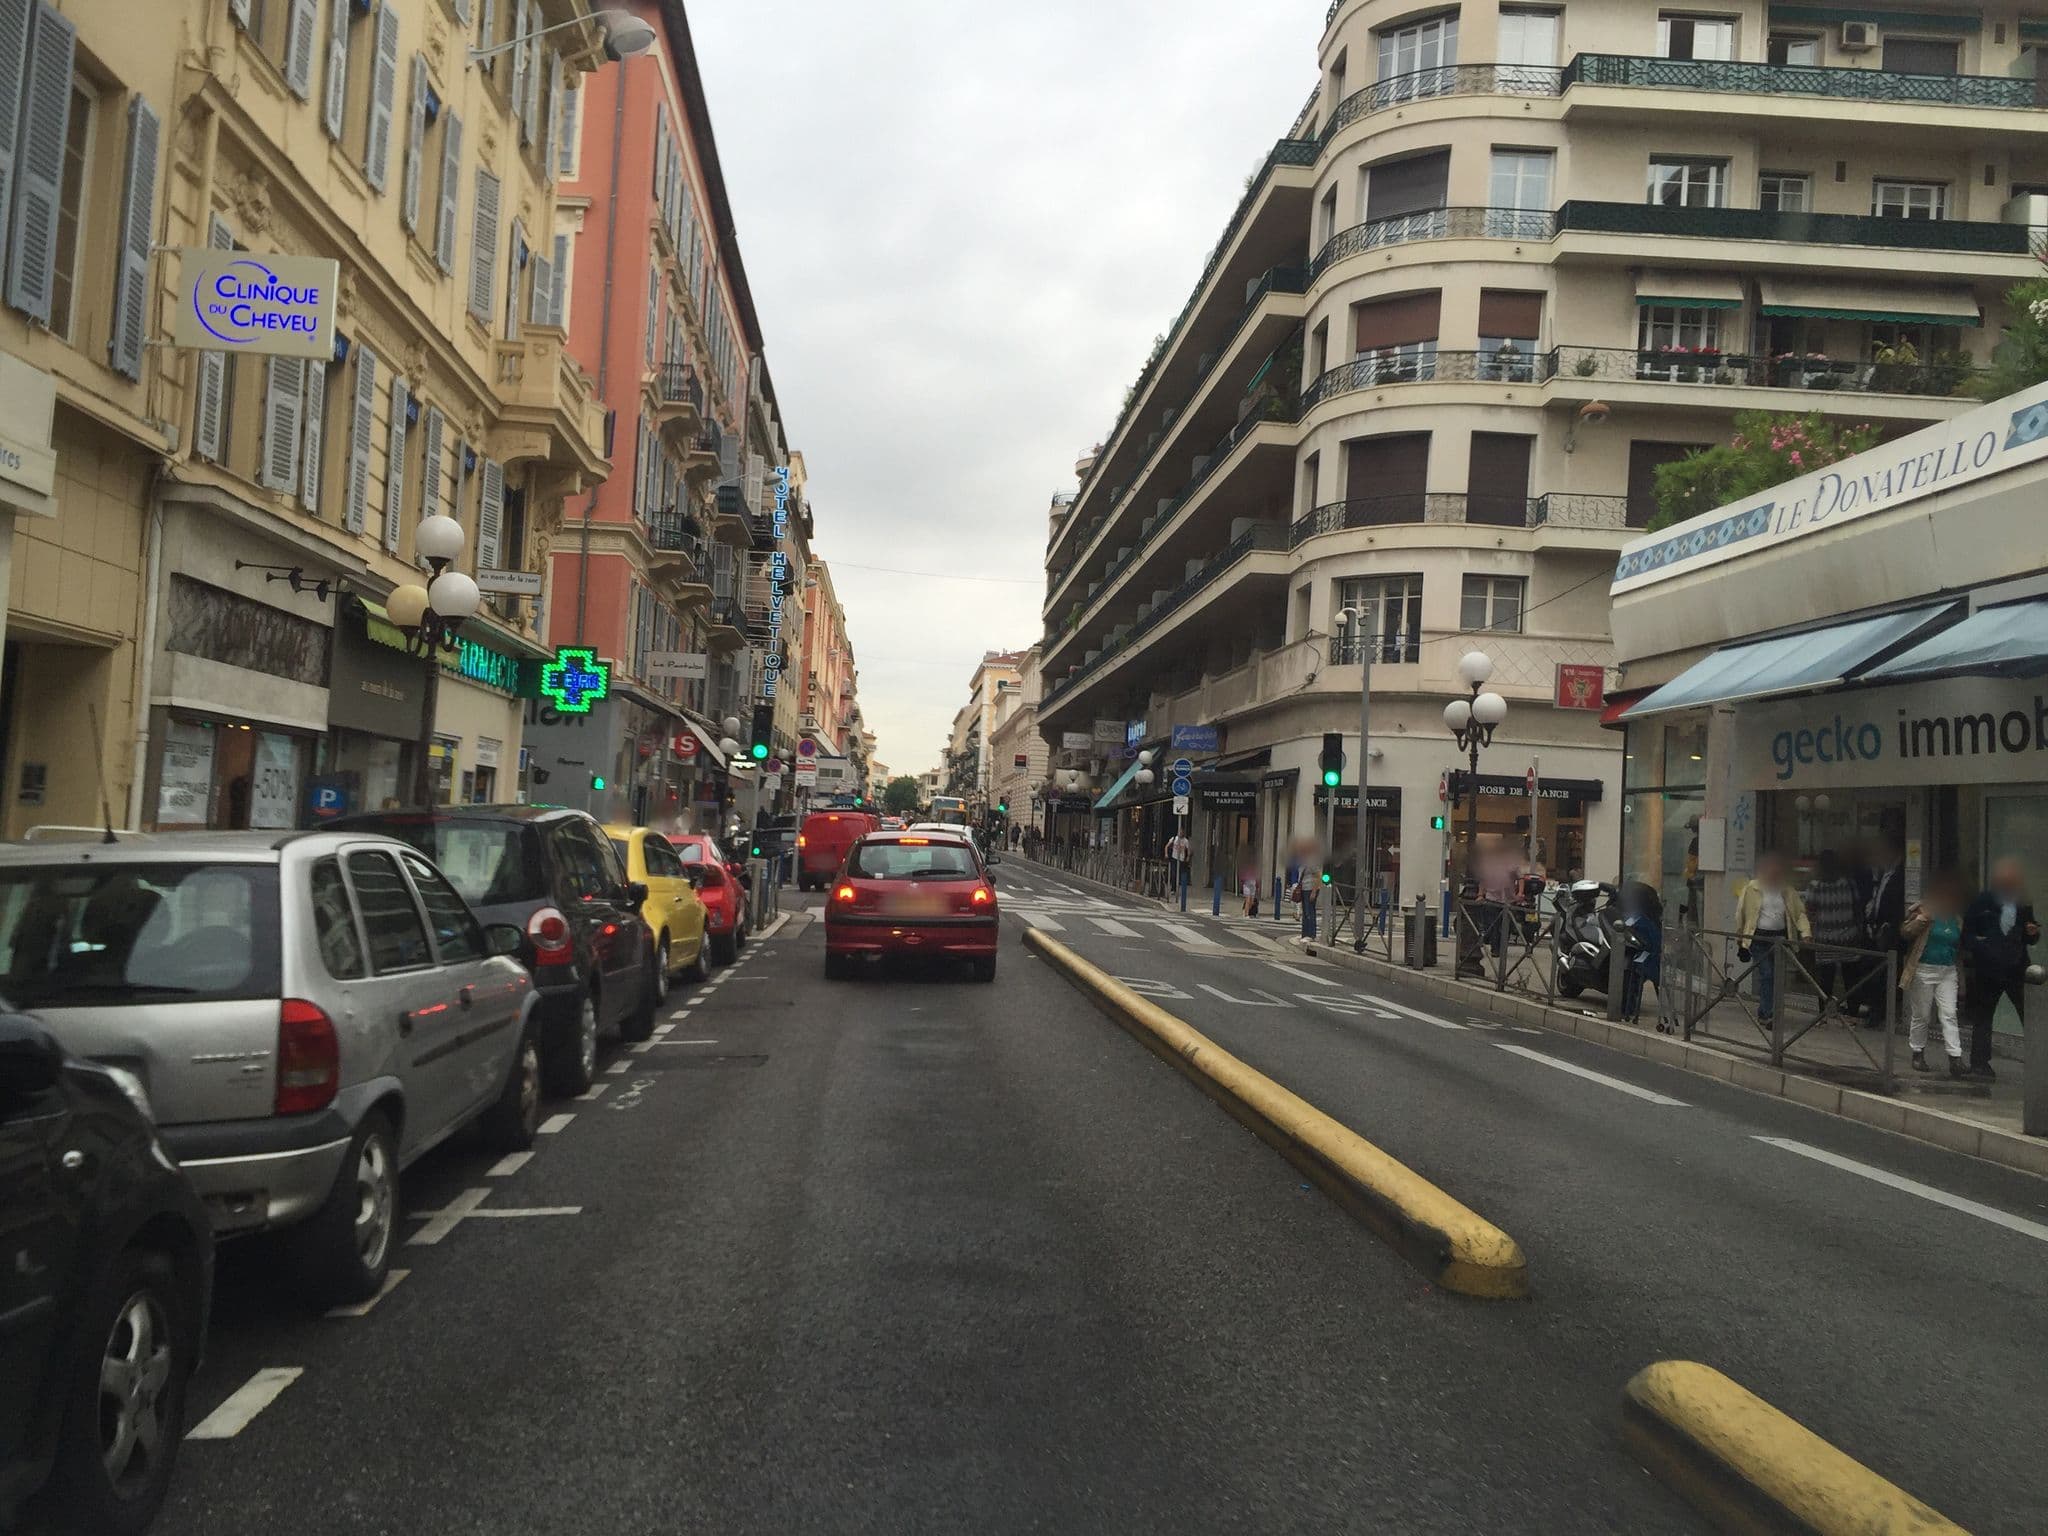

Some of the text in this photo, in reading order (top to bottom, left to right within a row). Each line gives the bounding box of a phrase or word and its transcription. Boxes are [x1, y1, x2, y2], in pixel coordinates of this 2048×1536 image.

[215, 274, 319, 305] CLINIQUE
[208, 303, 318, 333] DU CHEVEU
[1773, 430, 1996, 536] LE DONATELLO
[763, 466, 789, 698] HOTEL HELVETIQUE
[1771, 714, 1882, 780] gecko
[1479, 785, 1506, 795] ROSE
[1509, 787, 1523, 796] DE
[1116, 975, 1404, 1020] BUS
